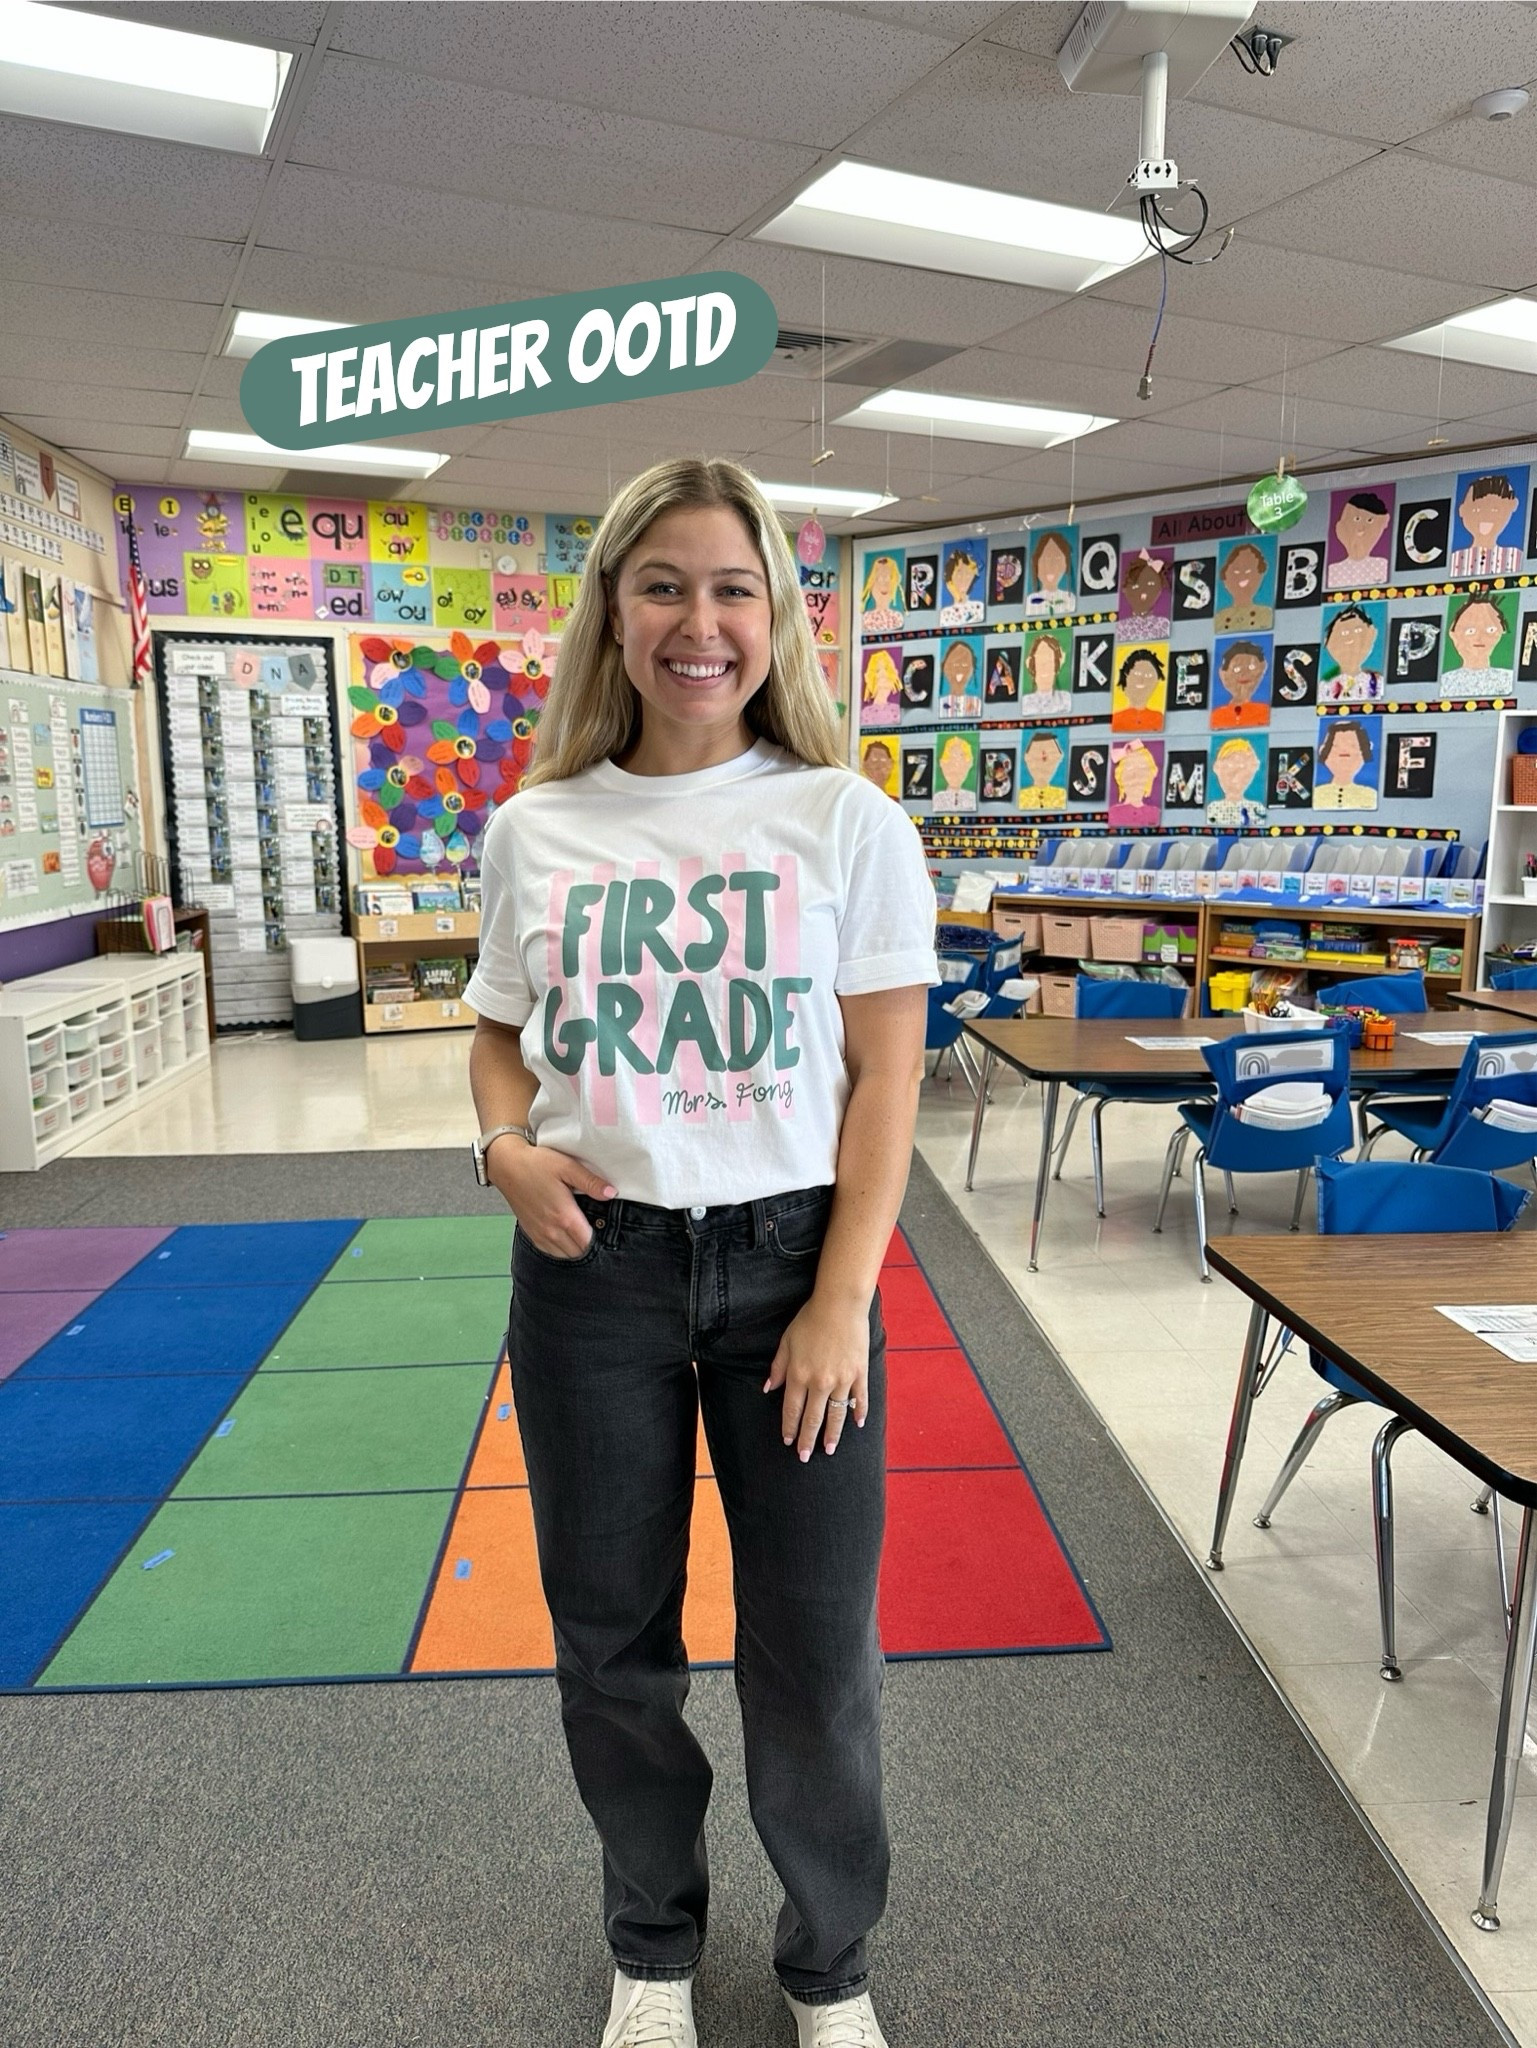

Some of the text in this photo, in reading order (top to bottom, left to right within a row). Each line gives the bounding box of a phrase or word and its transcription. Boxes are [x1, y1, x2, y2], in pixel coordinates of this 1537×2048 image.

[248, 495, 258, 505] a
[1260, 492, 1294, 507] Table
[259, 508, 269, 518] e
[383, 510, 409, 526] au
[1274, 507, 1282, 518] 3
[280, 509, 303, 536] e
[312, 512, 363, 550] qu
[1158, 510, 1245, 538] All About
[261, 532, 271, 542] o
[252, 544, 261, 553] u
[387, 540, 414, 556] aw
[910, 508, 1443, 610] R P Q S B C
[808, 572, 836, 588] ar
[331, 592, 363, 616] ed
[377, 589, 404, 603] ow
[437, 592, 453, 607] oi
[806, 592, 831, 613] ay
[398, 605, 426, 621] ou
[464, 607, 487, 624] oy
[241, 662, 309, 680] D N A
[903, 621, 1441, 706] C A K E S P
[906, 736, 1432, 804] Z B S M K F
[562, 871, 781, 978] FIRST
[544, 977, 813, 1077] GRADE
[662, 1080, 794, 1115] Mrs. Fong
